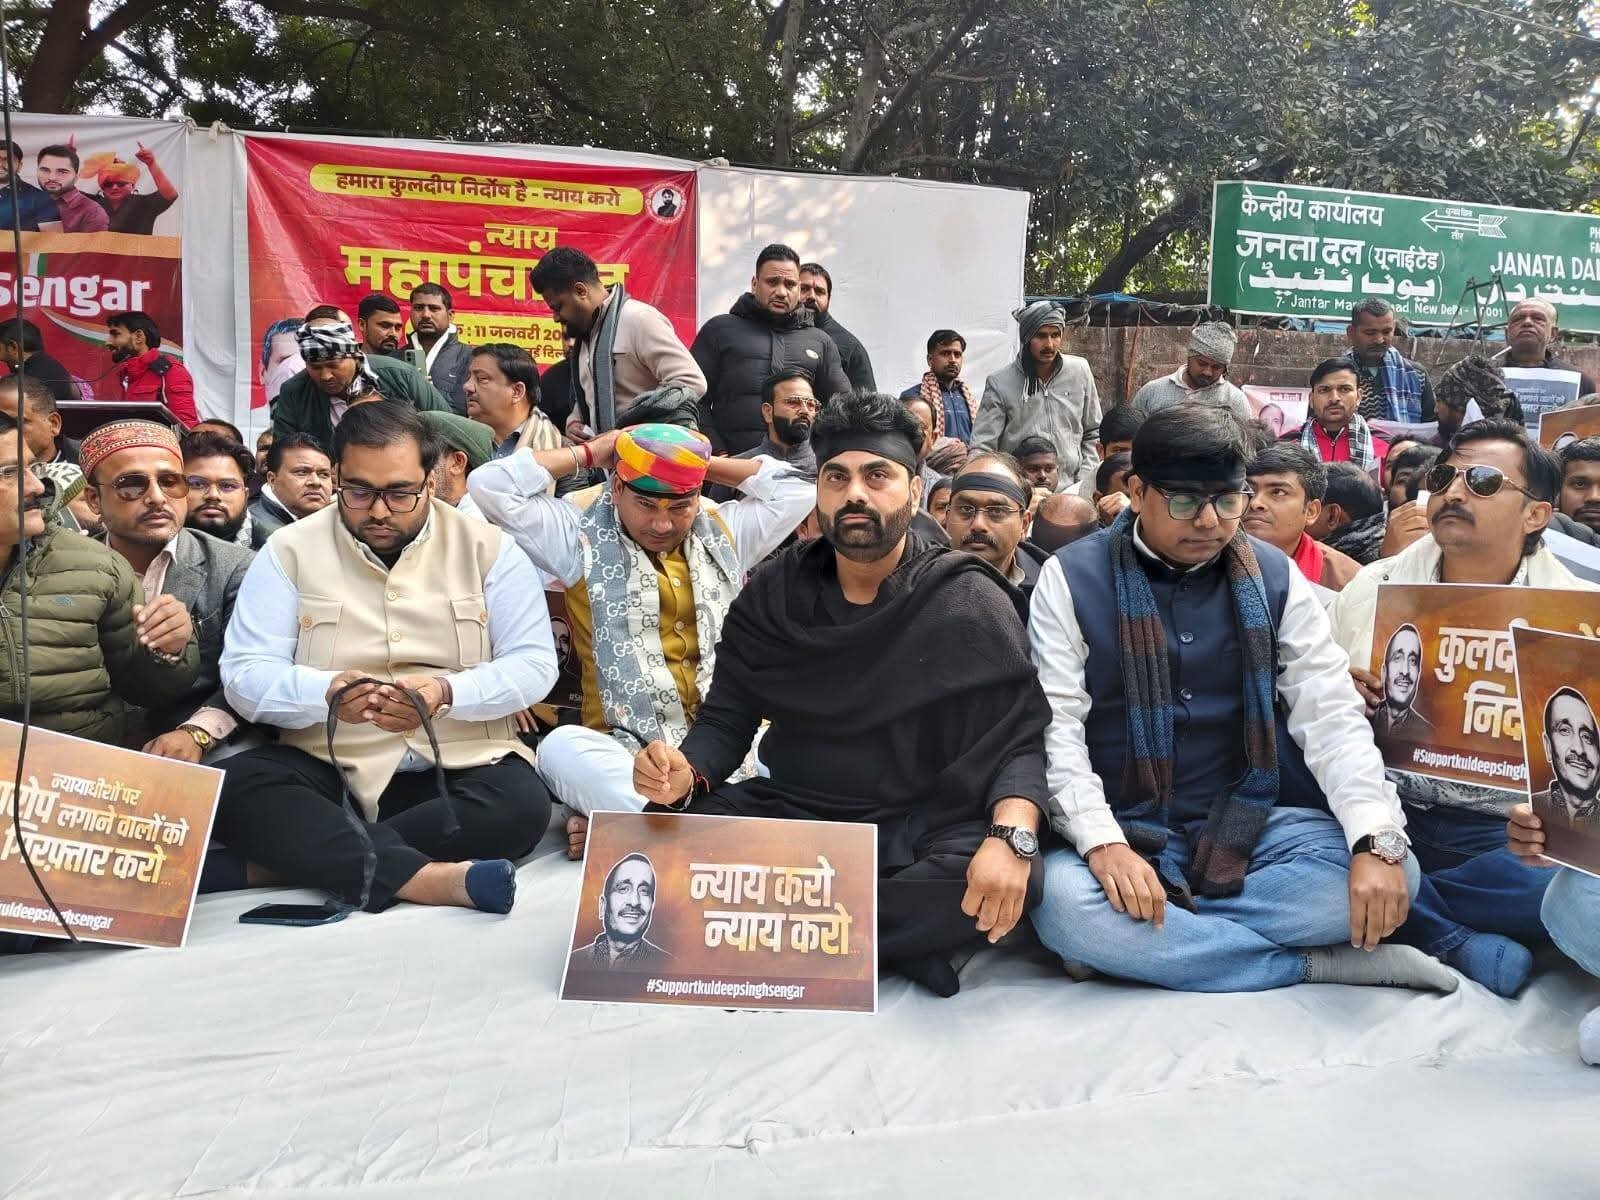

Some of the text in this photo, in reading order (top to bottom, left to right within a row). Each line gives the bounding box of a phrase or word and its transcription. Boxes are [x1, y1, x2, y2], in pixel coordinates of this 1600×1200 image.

[336, 172, 384, 190] हमारा
[387, 174, 457, 197] कुलदीप
[459, 176, 511, 199] निर्दोष
[515, 180, 527, 202] है
[543, 187, 584, 205] न्याय
[587, 188, 622, 207] करो
[1240, 186, 1385, 227] केन्द्रीय कार्यालय
[484, 223, 559, 251] न्याय
[1235, 229, 1445, 273] जनता दल (यूनाईटेड)
[1490, 250, 1566, 279] JANATA
[1291, 295, 1331, 310] Jantar
[1414, 303, 1438, 315] New
[475, 325, 486, 338] 11
[489, 323, 541, 341] जनवरी
[543, 329, 561, 341] 20
[51, 773, 142, 806] न्यायाधीशों पर
[57, 803, 117, 836] लगाने
[116, 811, 165, 843] वालों
[161, 815, 190, 847] को
[689, 854, 836, 908] न्याय करो
[703, 910, 787, 953] न्याय
[646, 978, 806, 1000] #Supportkuldeepsinghsengar
